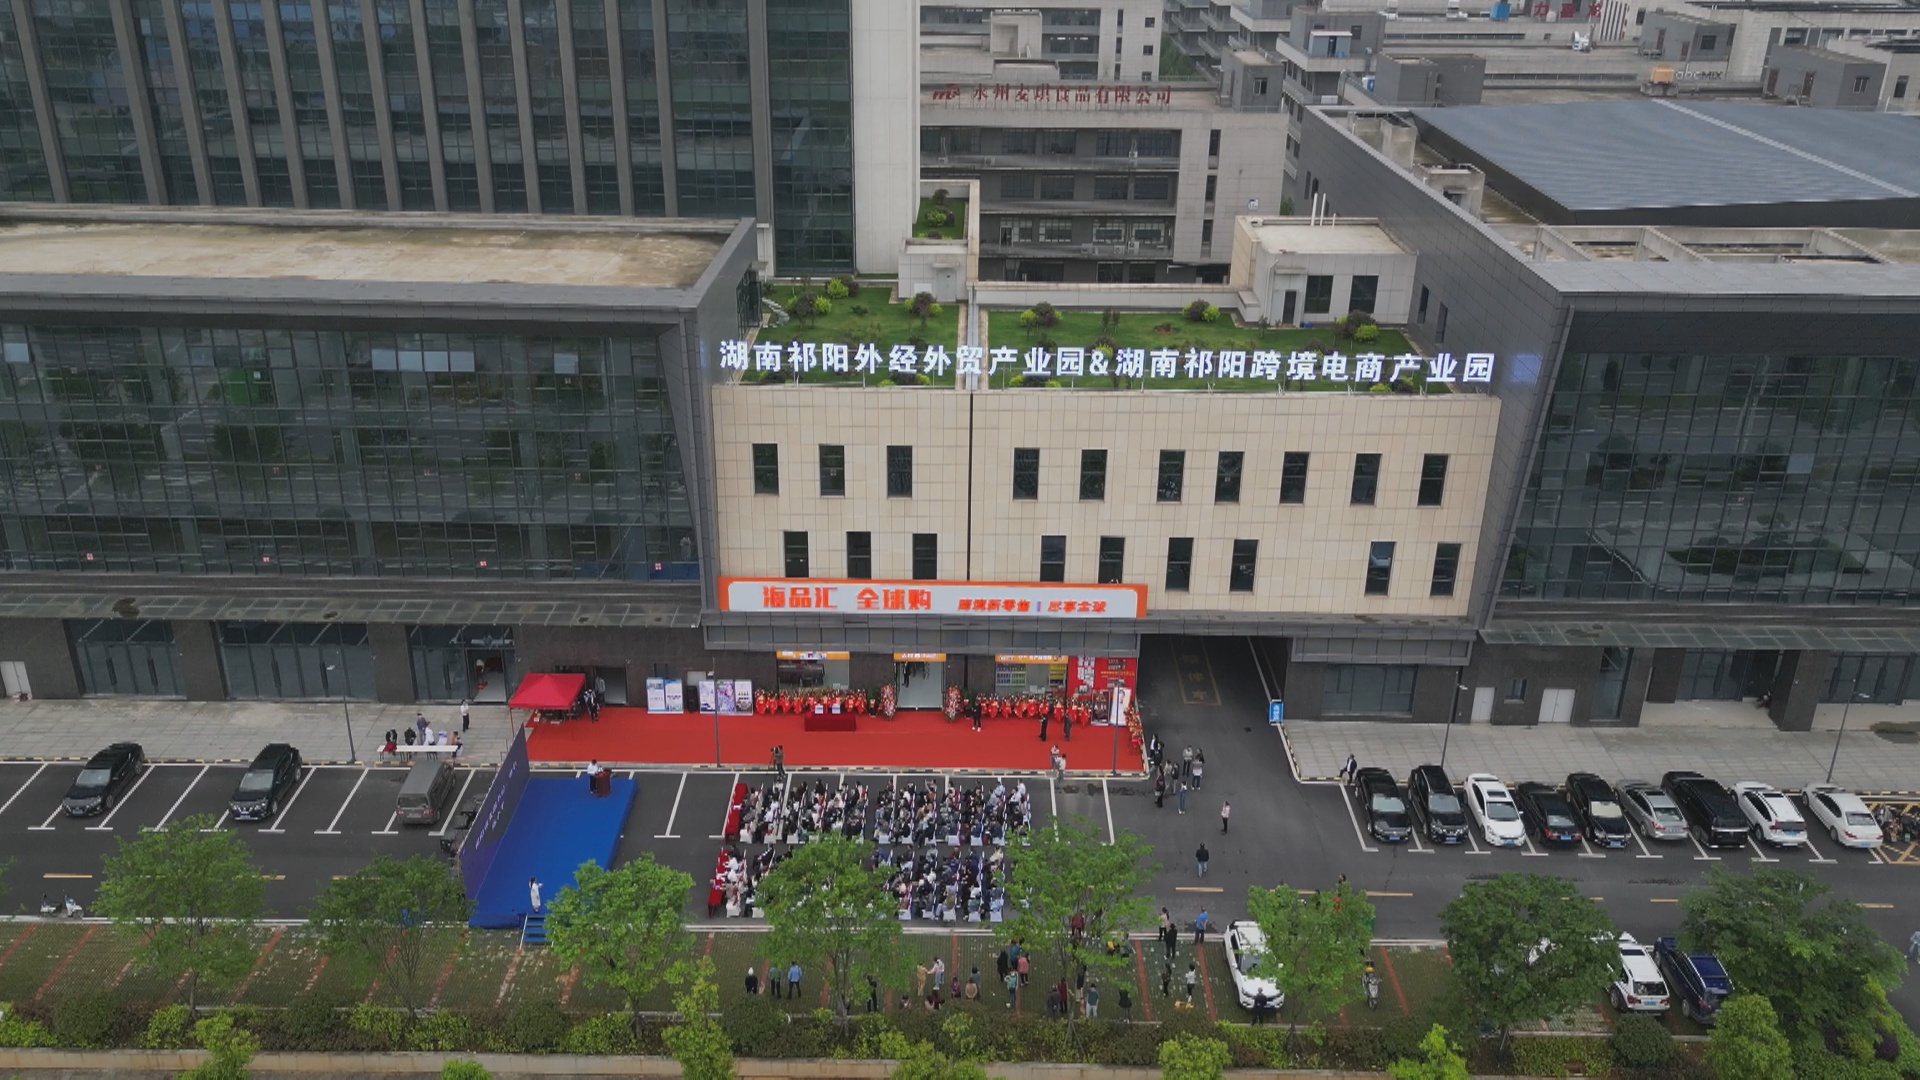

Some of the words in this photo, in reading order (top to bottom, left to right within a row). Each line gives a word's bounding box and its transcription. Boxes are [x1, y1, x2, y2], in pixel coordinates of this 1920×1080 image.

[762, 585, 838, 609] 海品汇
[856, 587, 932, 610] 全球购
